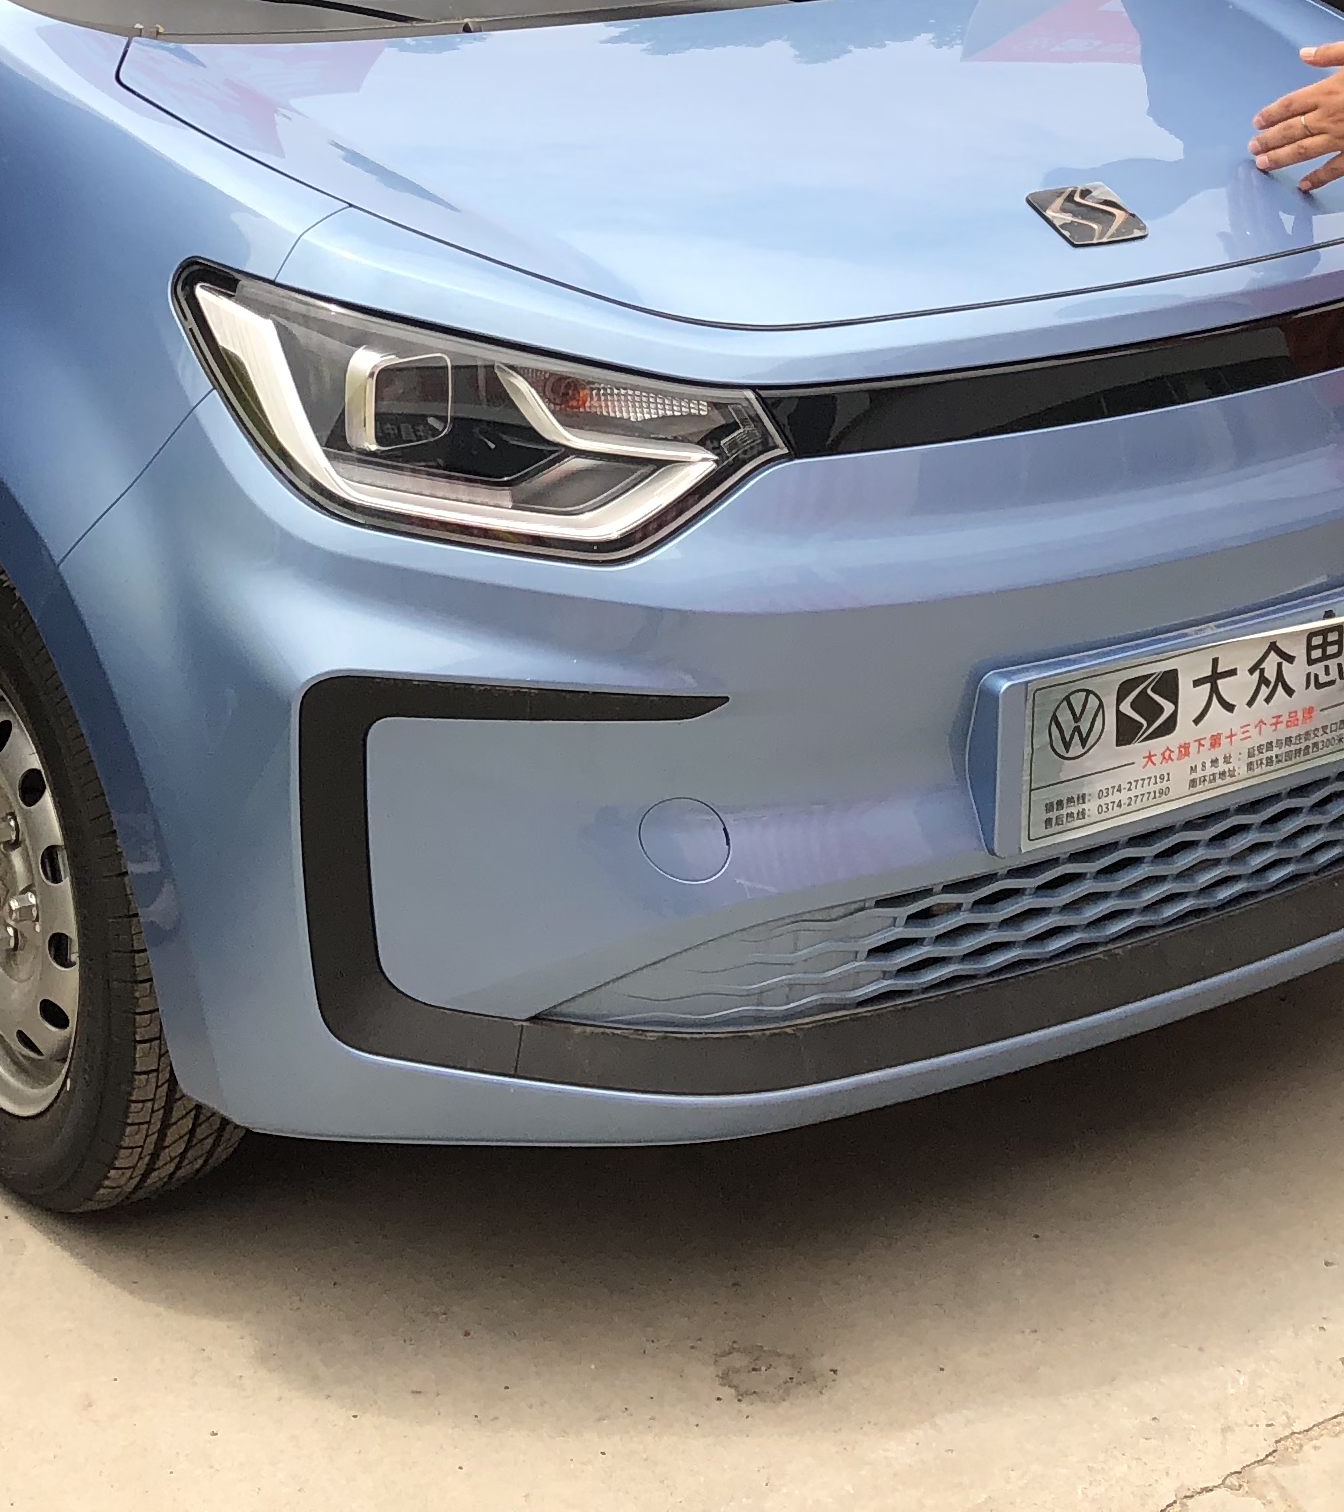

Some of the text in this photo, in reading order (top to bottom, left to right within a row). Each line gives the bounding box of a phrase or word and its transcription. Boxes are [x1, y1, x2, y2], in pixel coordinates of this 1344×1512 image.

[1142, 705, 1316, 769] 大众旗下第十三个子品牌
